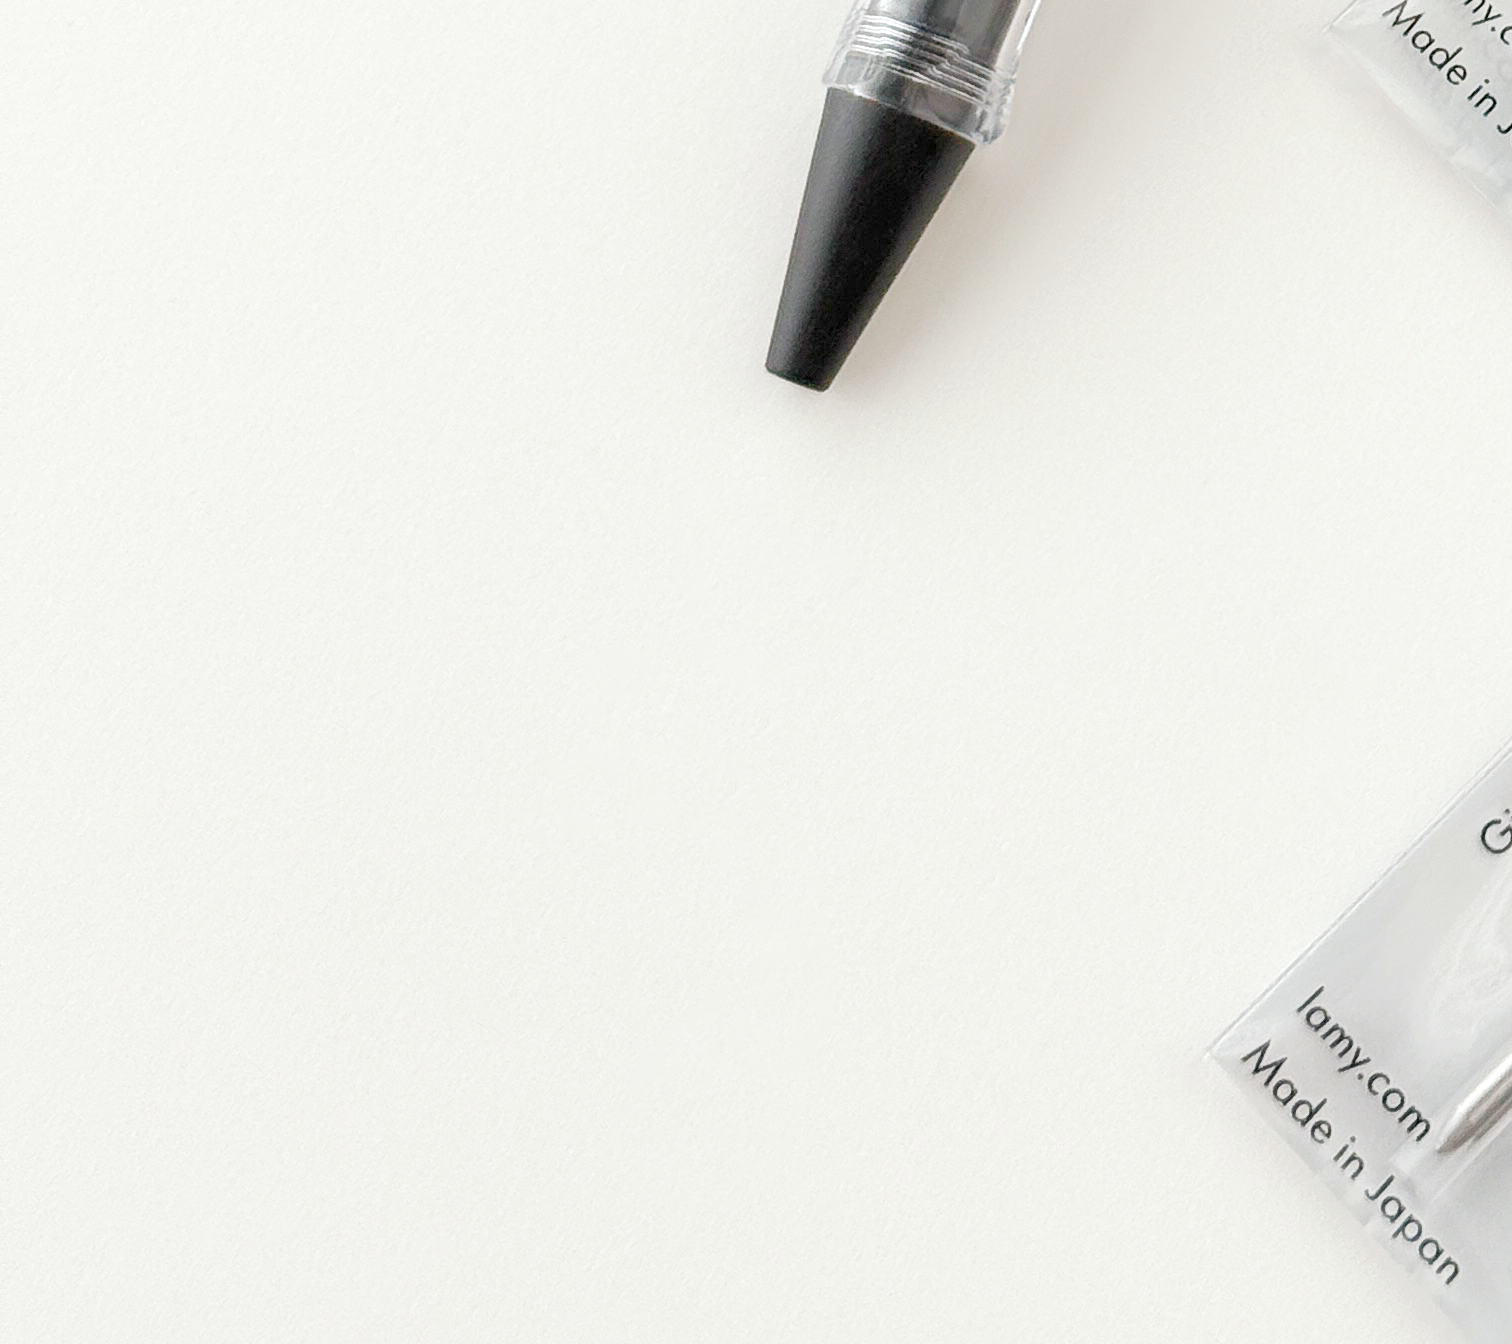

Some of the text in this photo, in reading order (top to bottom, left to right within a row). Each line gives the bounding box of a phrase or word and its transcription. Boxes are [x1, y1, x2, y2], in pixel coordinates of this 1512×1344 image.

[1466, 78, 1498, 118] in
[1296, 984, 1431, 1143] lamy.com
[1240, 1039, 1460, 1286] Made in Japan
